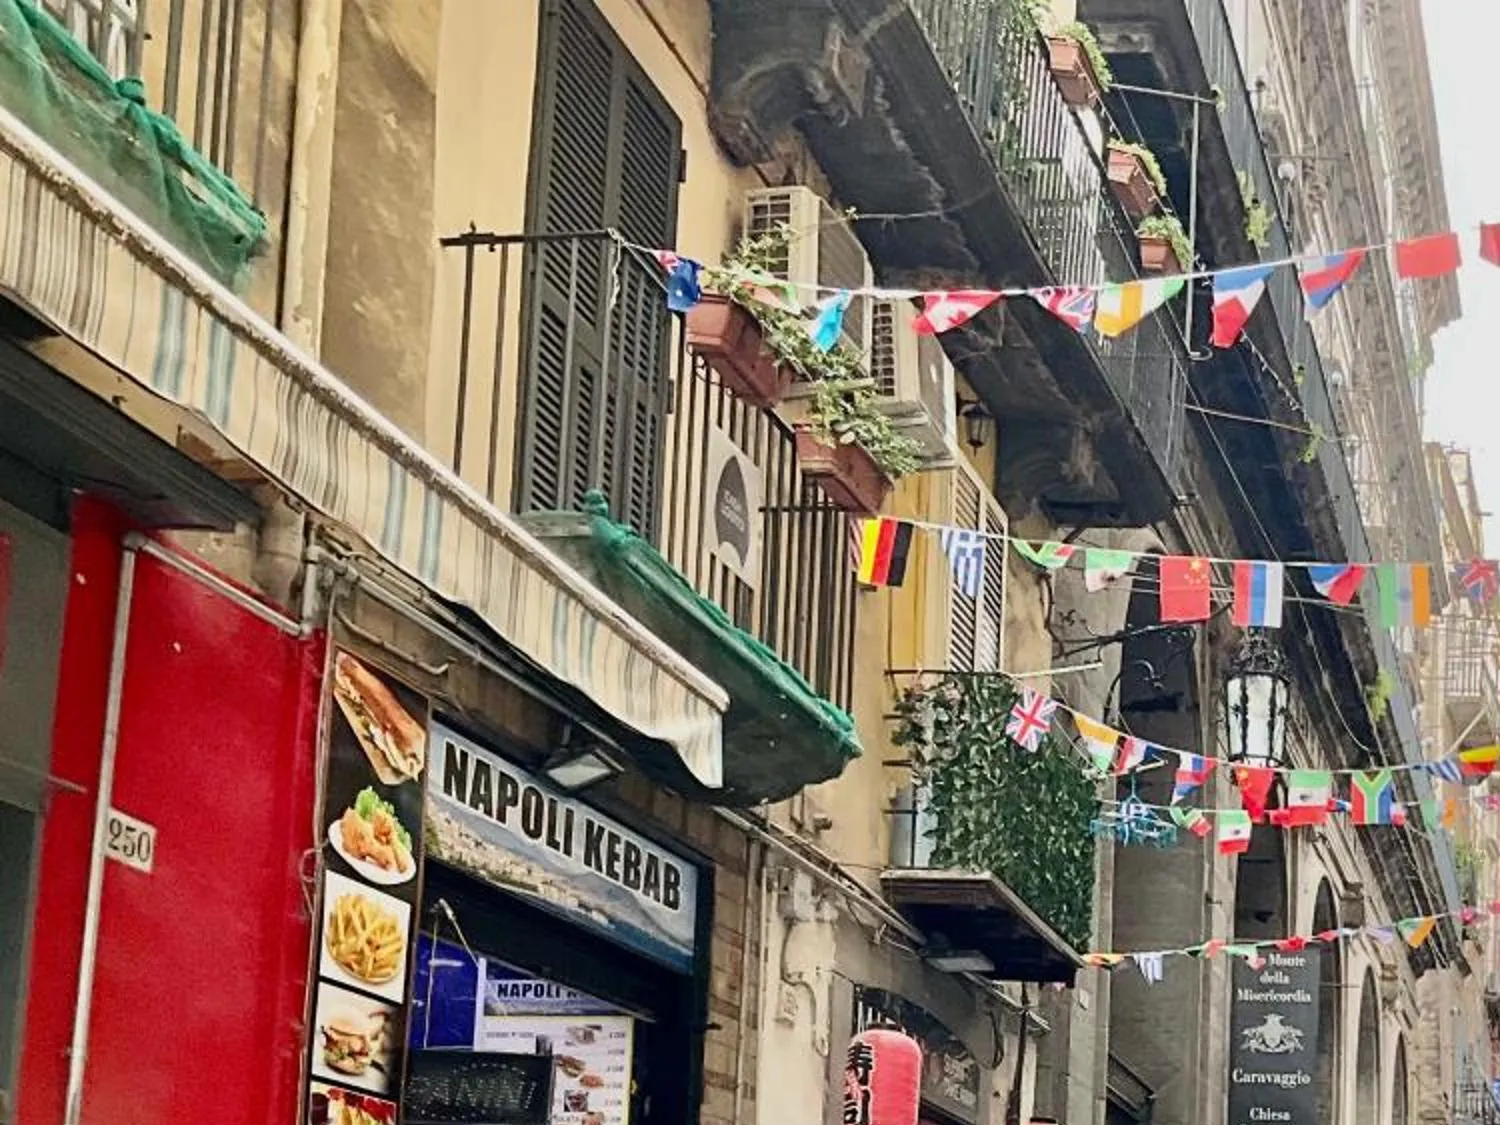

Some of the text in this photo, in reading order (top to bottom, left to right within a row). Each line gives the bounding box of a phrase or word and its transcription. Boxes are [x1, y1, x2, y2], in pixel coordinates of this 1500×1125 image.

[442, 739, 683, 913] NAPOLI KEBAB
[108, 818, 151, 862] 250
[1259, 970, 1291, 985] della
[497, 982, 561, 999] NAPOLI
[1236, 987, 1312, 1003] Misericordia
[1232, 1067, 1311, 1089] Caravaggio
[1249, 1106, 1292, 1121] Chiesa
